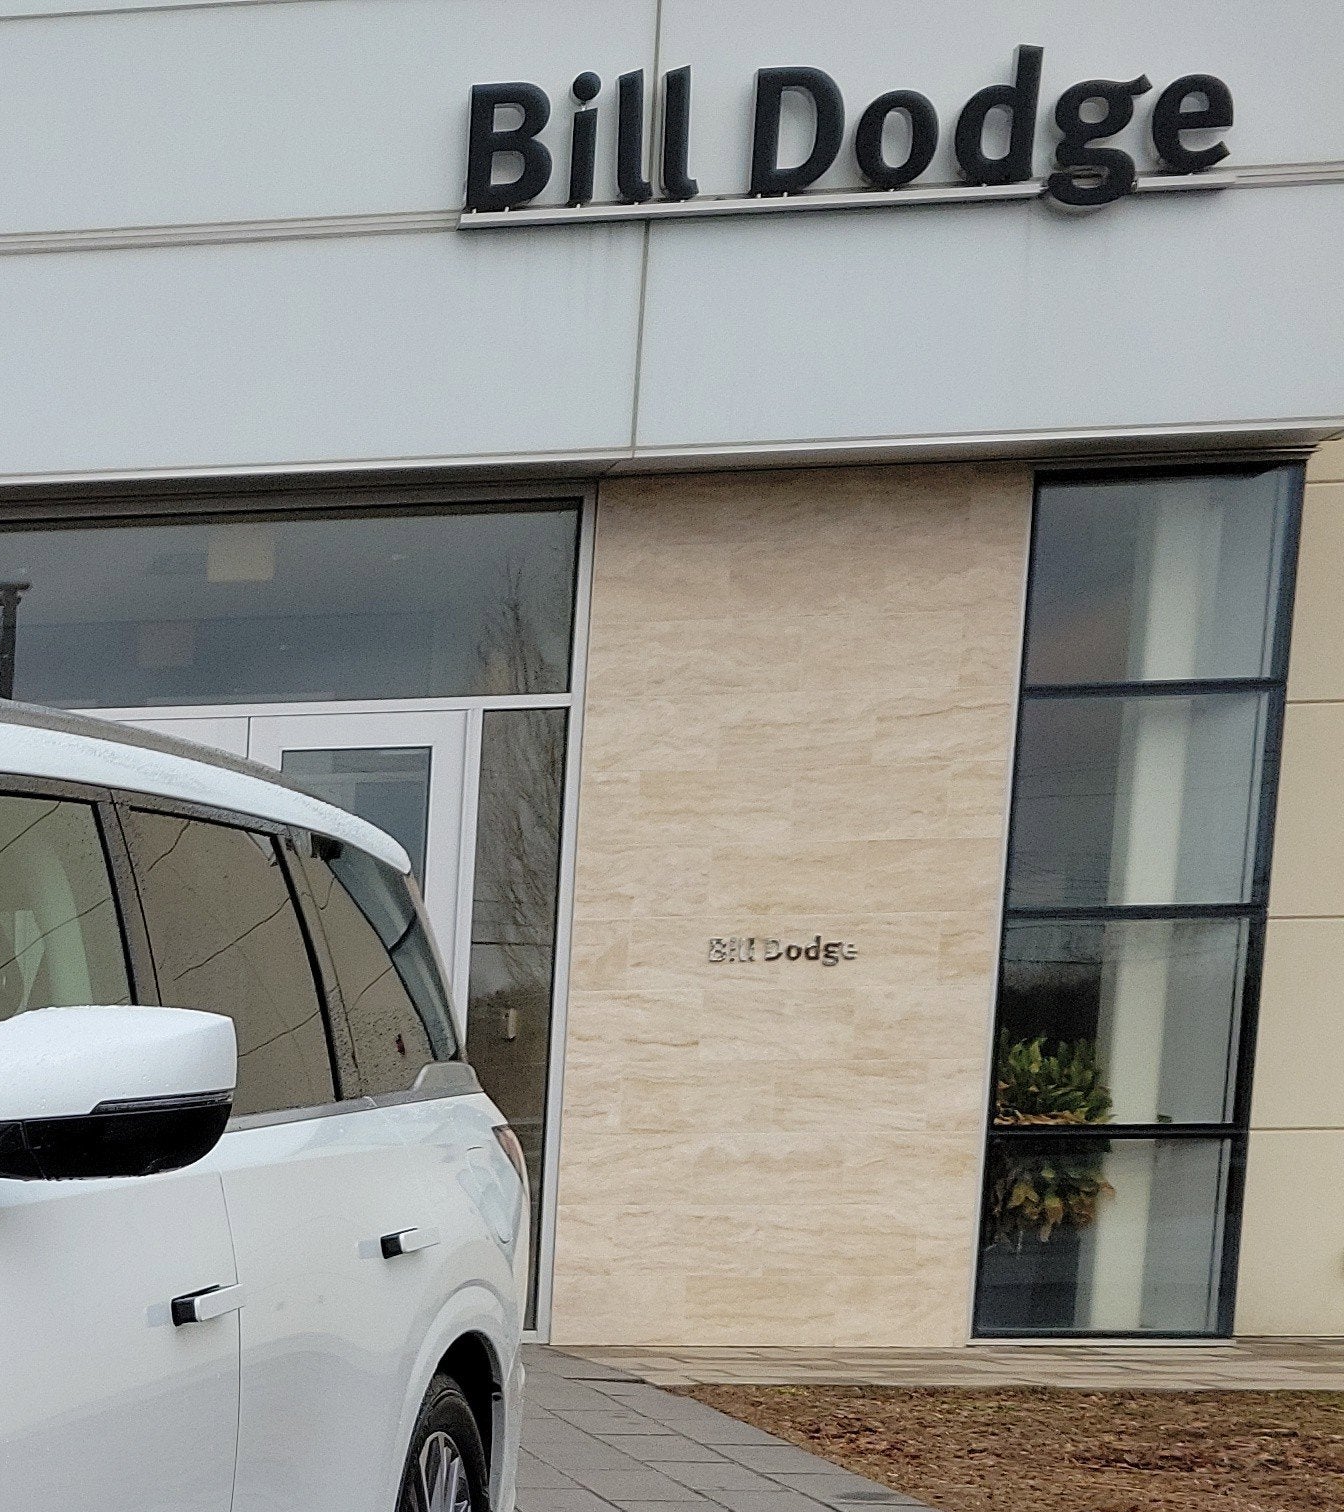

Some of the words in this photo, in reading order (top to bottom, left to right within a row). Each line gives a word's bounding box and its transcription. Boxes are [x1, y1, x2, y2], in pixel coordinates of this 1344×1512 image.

[466, 64, 698, 213] Bill
[750, 44, 1235, 205] Dodge
[708, 936, 756, 963] Bill
[764, 933, 859, 966] Dodge
